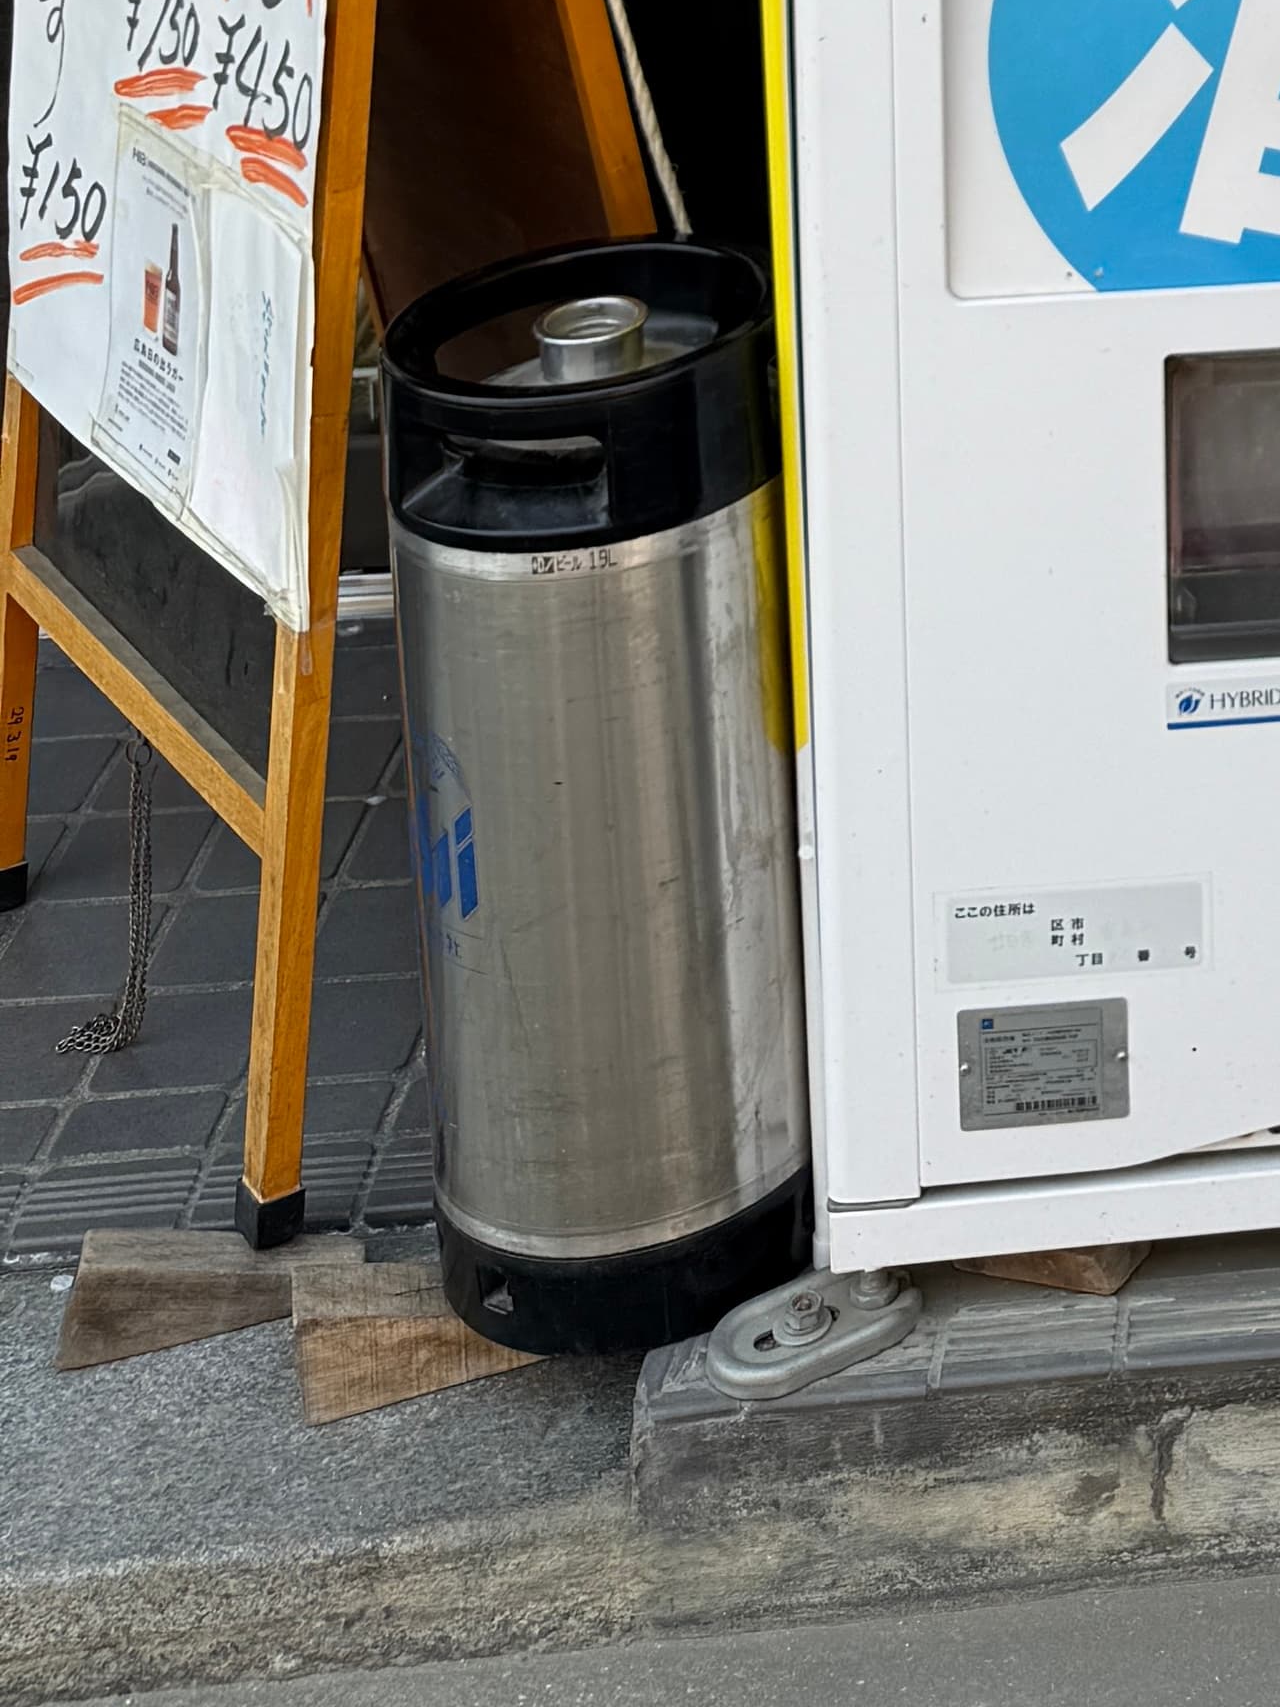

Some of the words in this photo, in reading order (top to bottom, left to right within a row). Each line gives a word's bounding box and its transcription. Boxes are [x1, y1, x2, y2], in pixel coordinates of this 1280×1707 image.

[213, 14, 313, 150] ¥450
[20, 133, 107, 243] ¥150
[954, 902, 1036, 920] ここの住所は
[1071, 917, 1085, 931] 市
[1051, 934, 1064, 948] 町
[1071, 933, 1085, 947] 村
